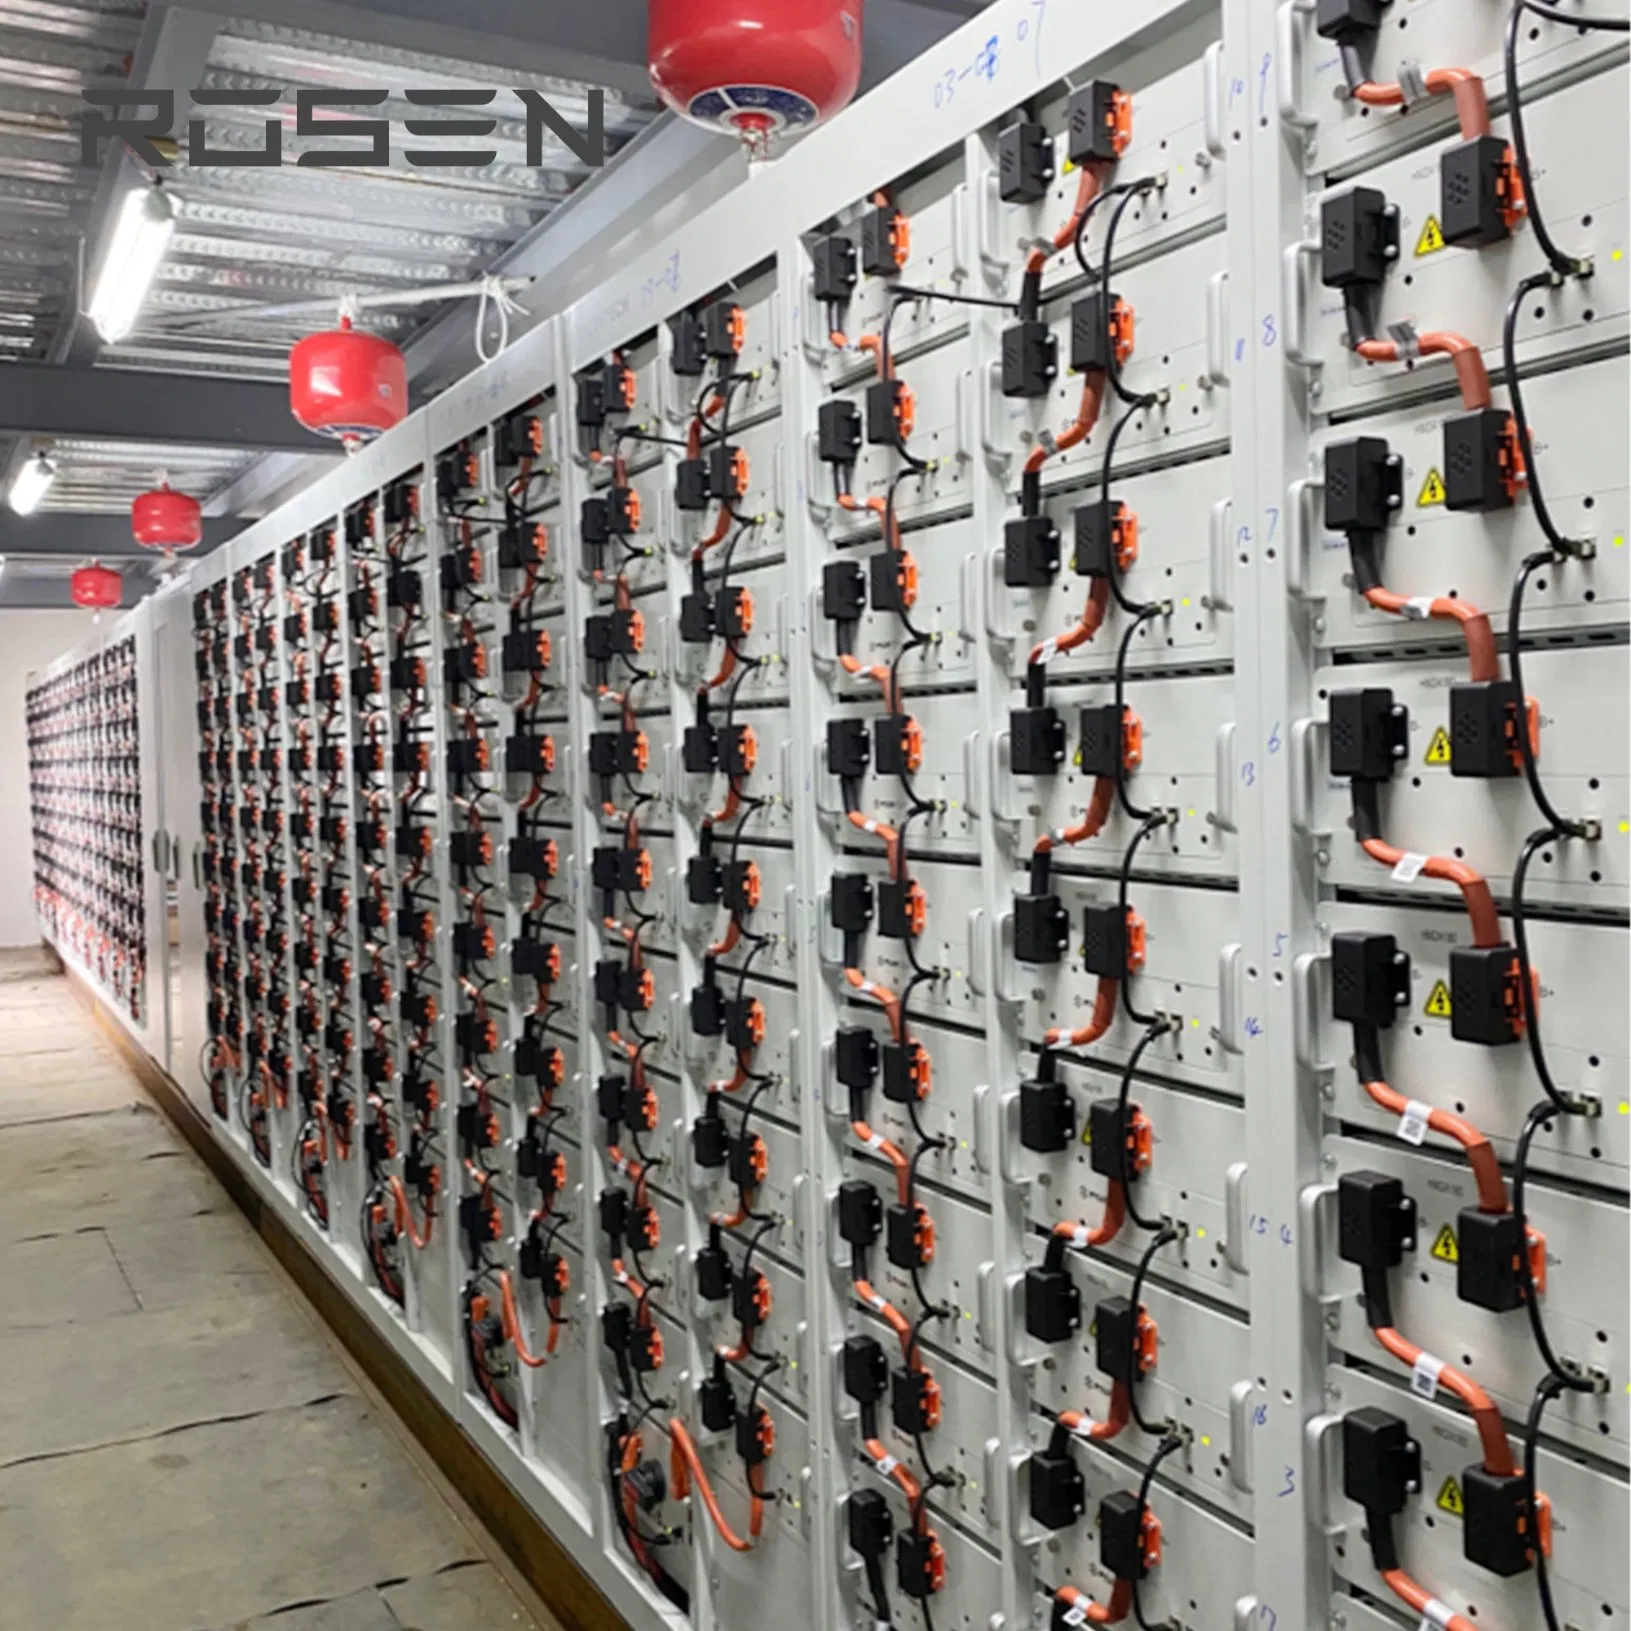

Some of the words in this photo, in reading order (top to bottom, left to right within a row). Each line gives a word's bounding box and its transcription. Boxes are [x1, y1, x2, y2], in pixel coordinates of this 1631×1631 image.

[1263, 313, 1277, 347] 8
[1264, 507, 1279, 543] 7
[1266, 720, 1282, 755] 6
[1277, 1465, 1296, 1498] 3
